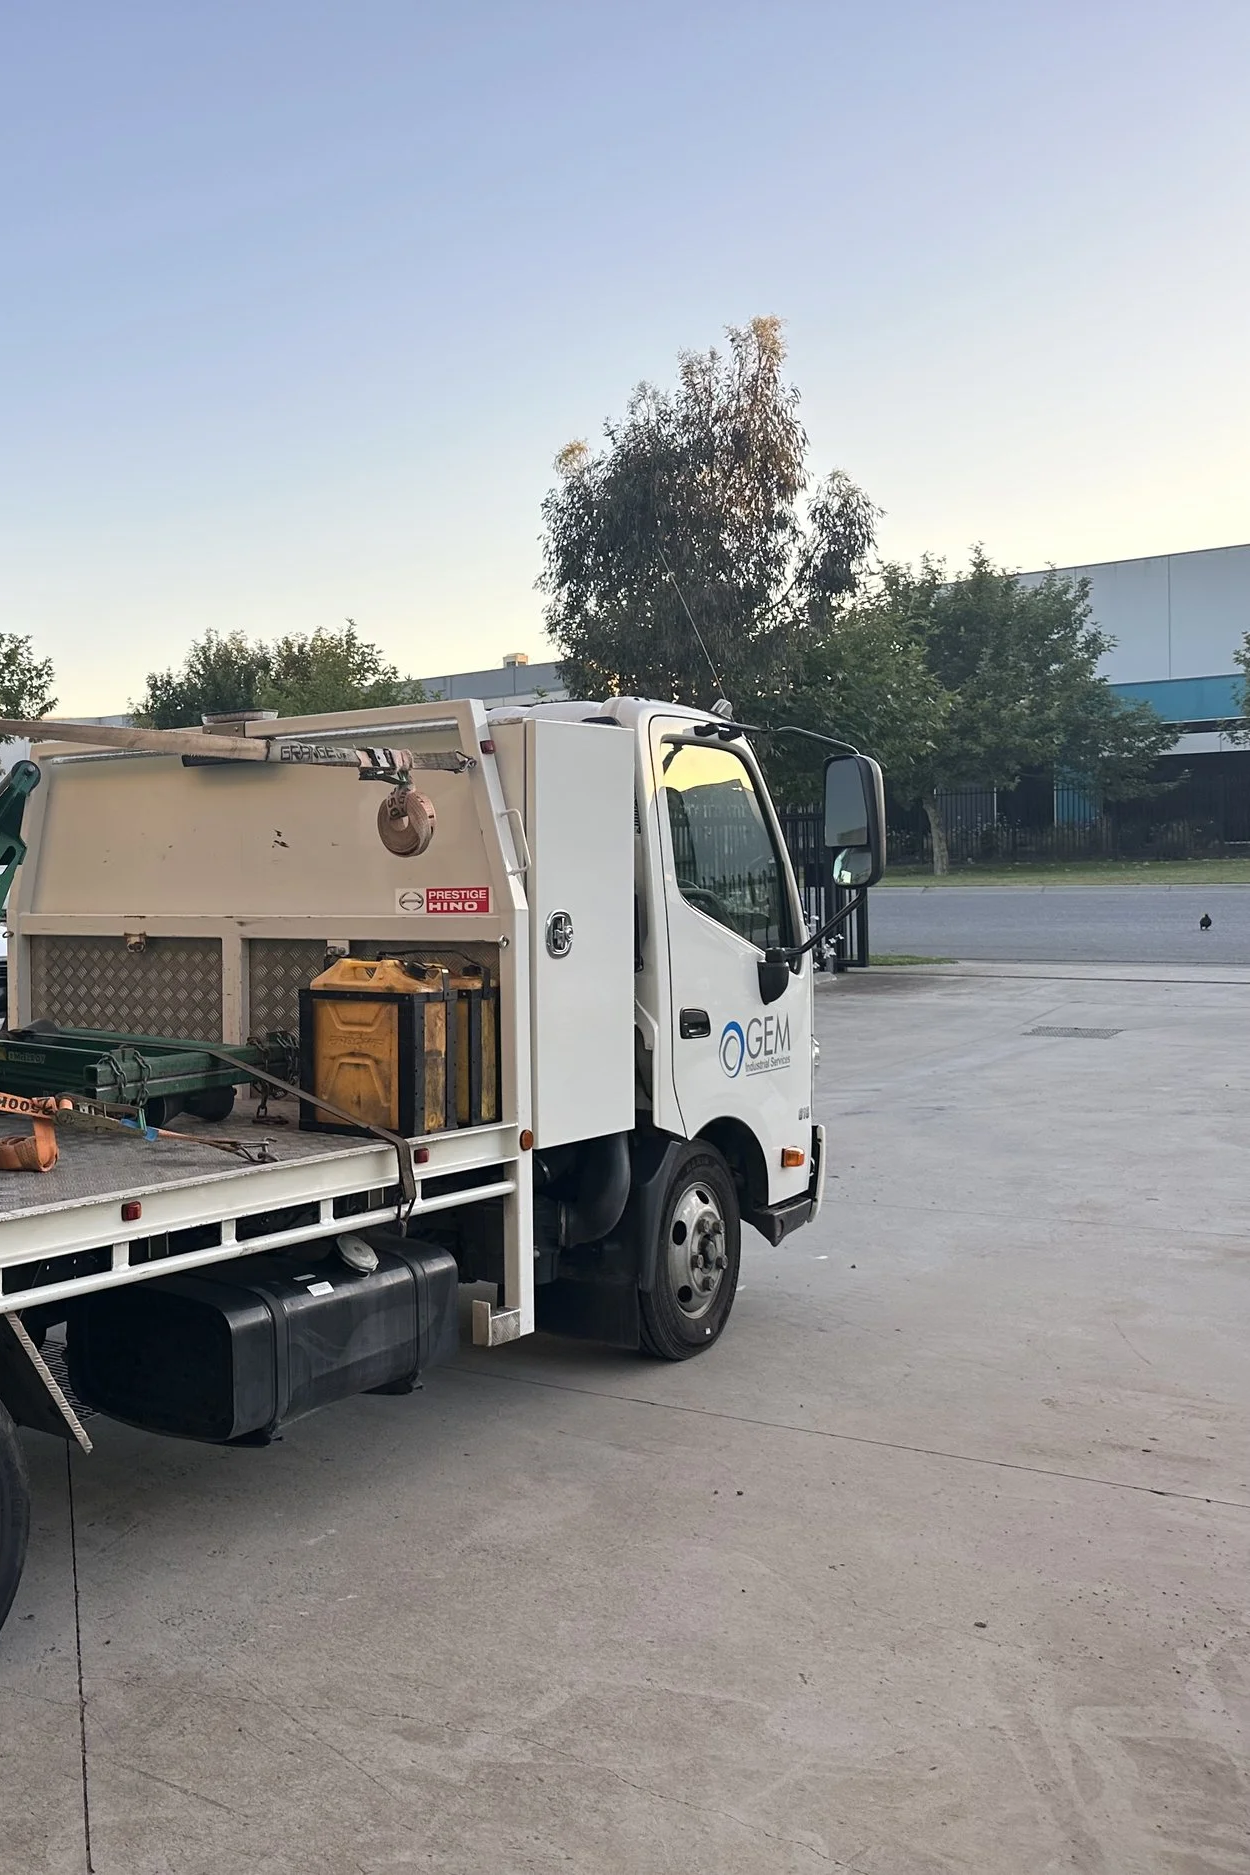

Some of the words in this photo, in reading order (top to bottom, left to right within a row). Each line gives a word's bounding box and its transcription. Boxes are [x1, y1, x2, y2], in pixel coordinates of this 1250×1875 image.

[279, 744, 336, 761] GRANGE
[428, 888, 487, 900] PRESTIGE
[428, 901, 478, 911] HINO
[746, 1012, 791, 1060] GEM
[745, 1058, 770, 1073] Industrial
[770, 1055, 791, 1068] Services
